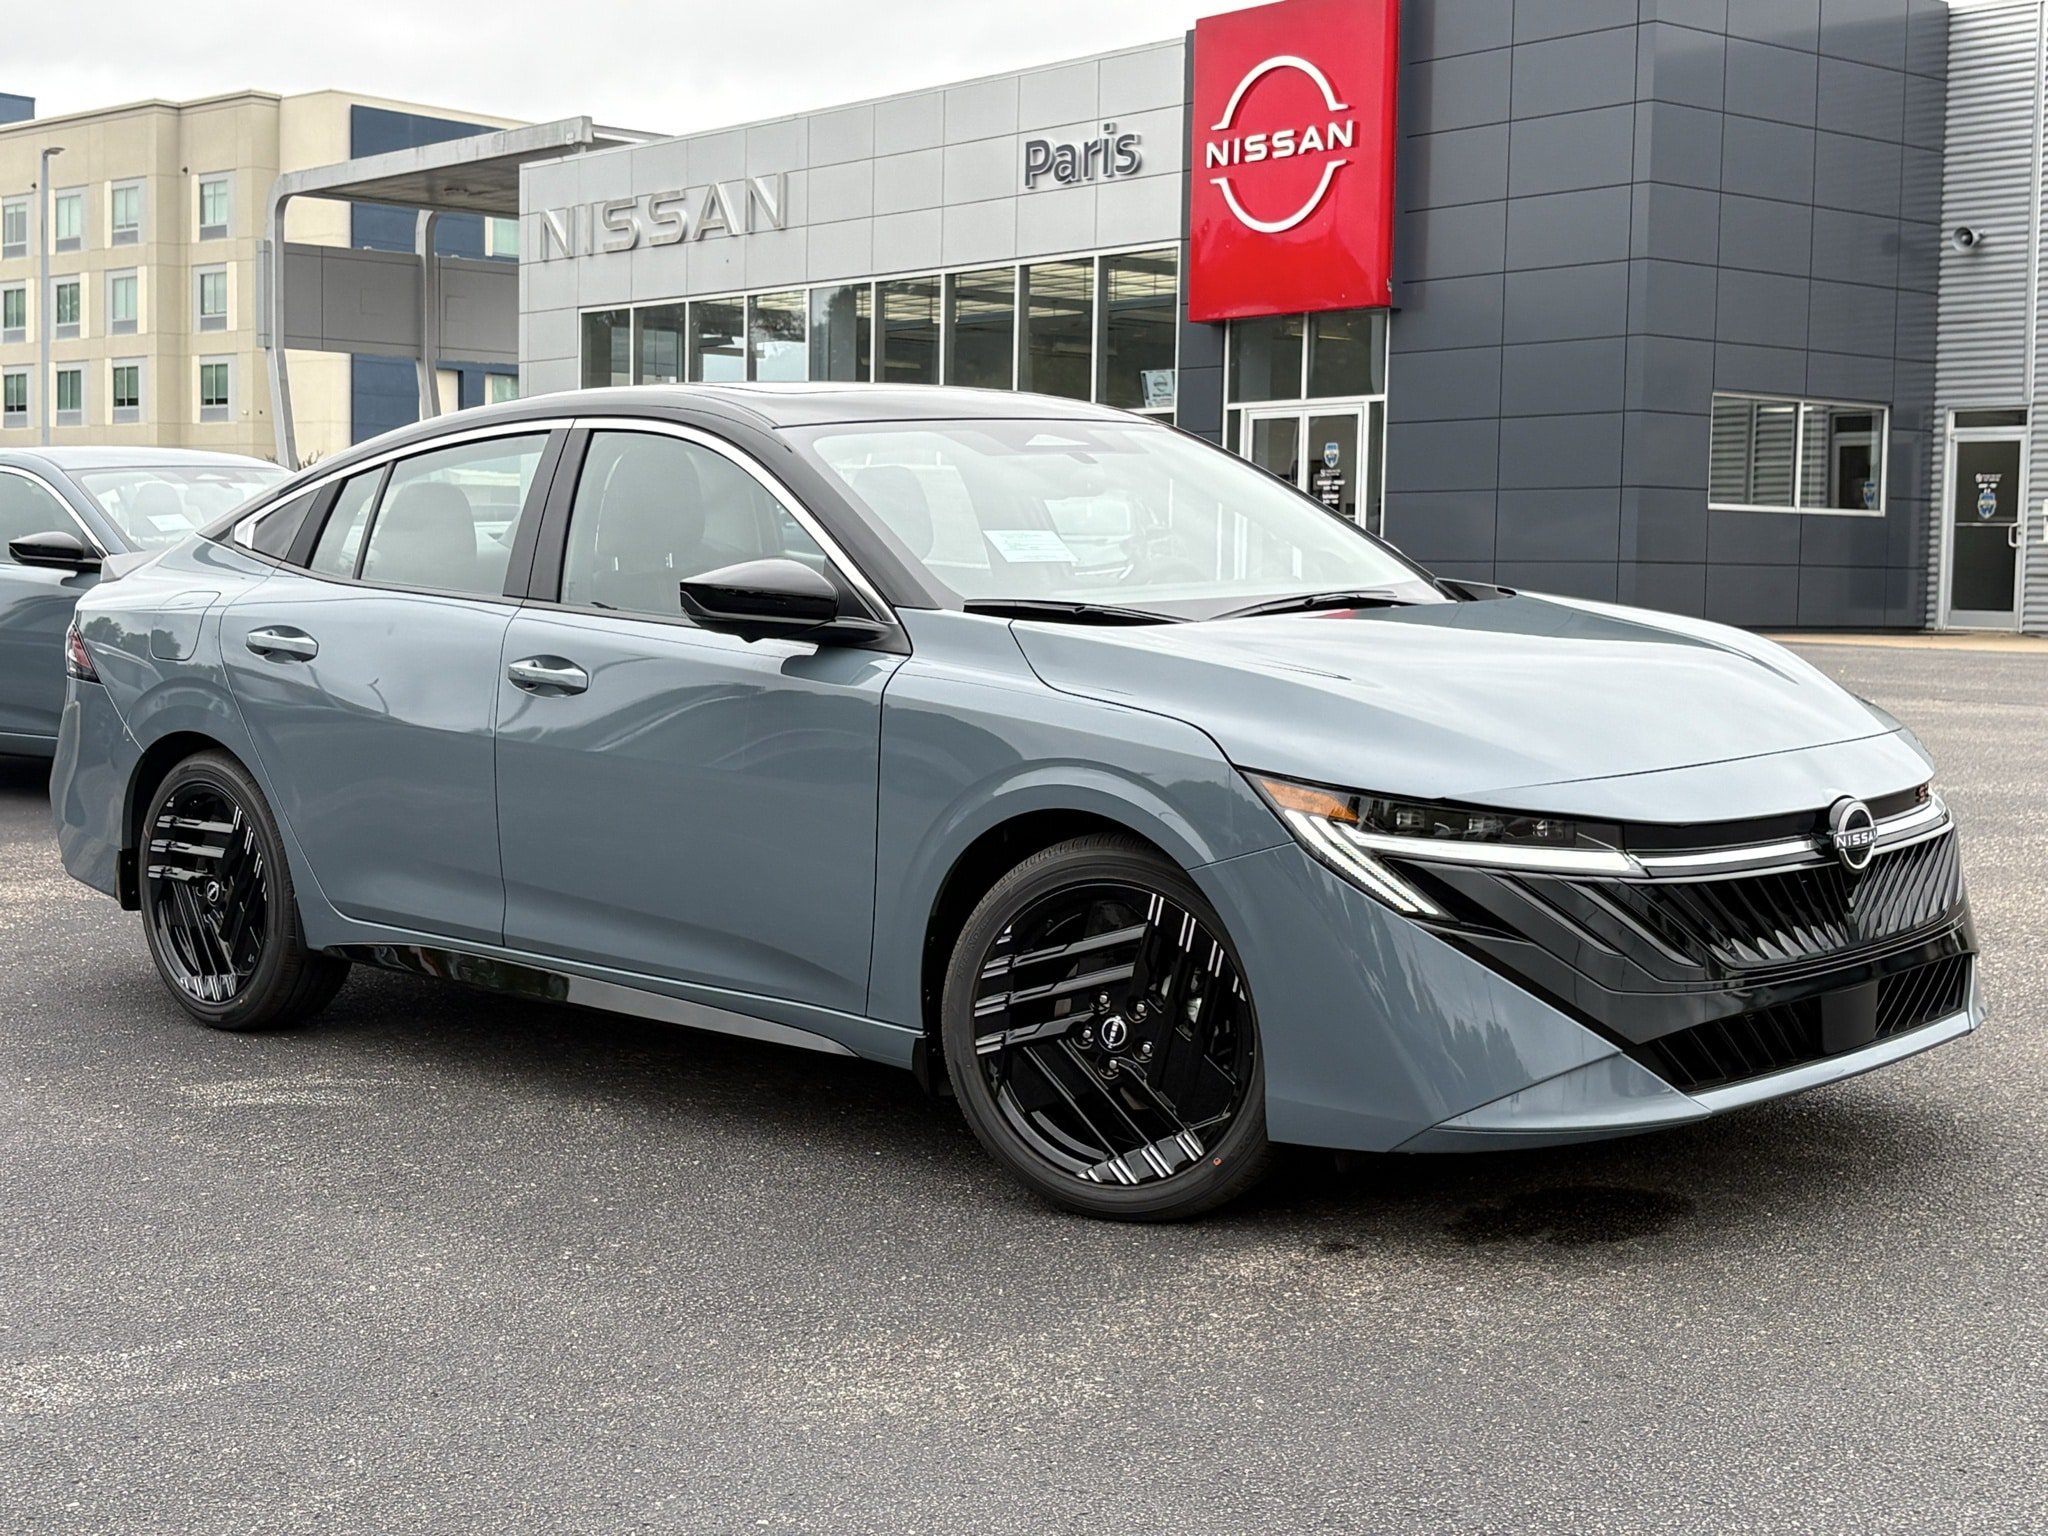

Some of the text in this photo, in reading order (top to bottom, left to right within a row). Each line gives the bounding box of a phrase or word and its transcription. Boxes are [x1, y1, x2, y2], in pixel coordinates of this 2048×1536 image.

[1025, 121, 1142, 189] Paris
[1206, 119, 1354, 169] NISSAN
[540, 172, 788, 262] NISSAN
